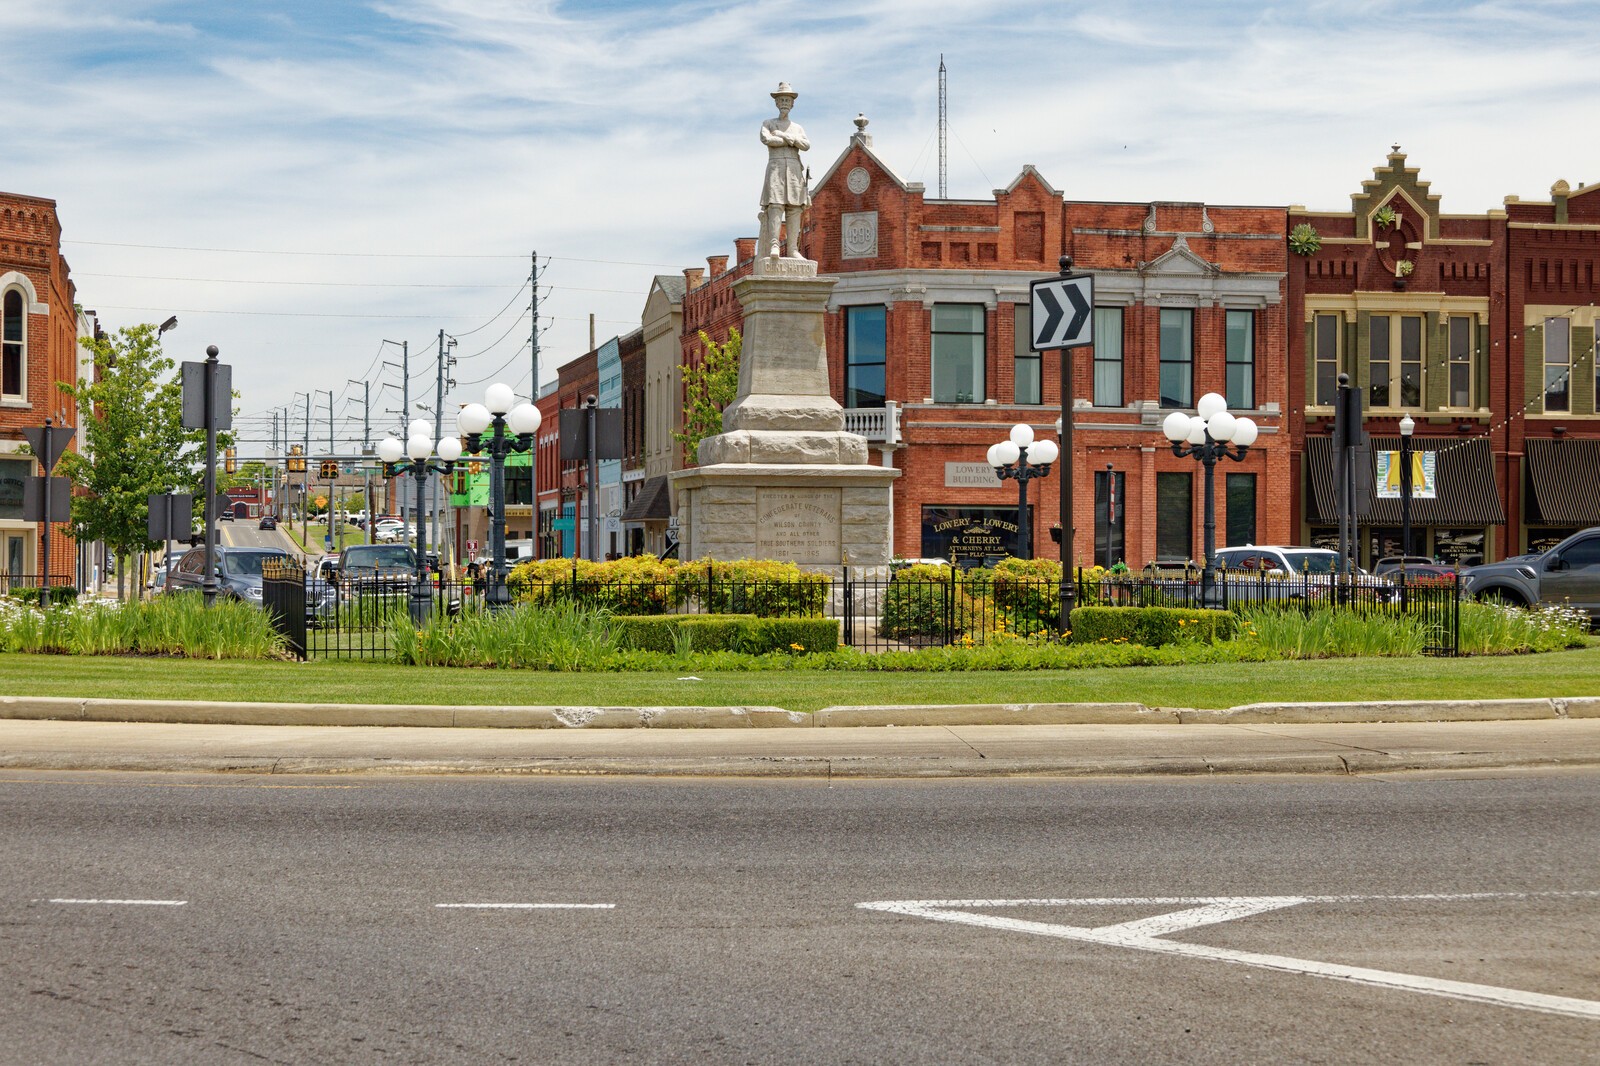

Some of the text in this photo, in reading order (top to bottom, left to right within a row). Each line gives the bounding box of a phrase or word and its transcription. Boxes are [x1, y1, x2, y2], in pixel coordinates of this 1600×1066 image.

[848, 227, 872, 244] 1898
[956, 466, 991, 474] LOWERY
[760, 503, 836, 524] CONFEDERATE VETERANS
[671, 518, 680, 527] JC
[933, 518, 971, 533] LOWERY
[983, 518, 1019, 533] LOWERY
[952, 536, 1002, 544] & CHERRY
